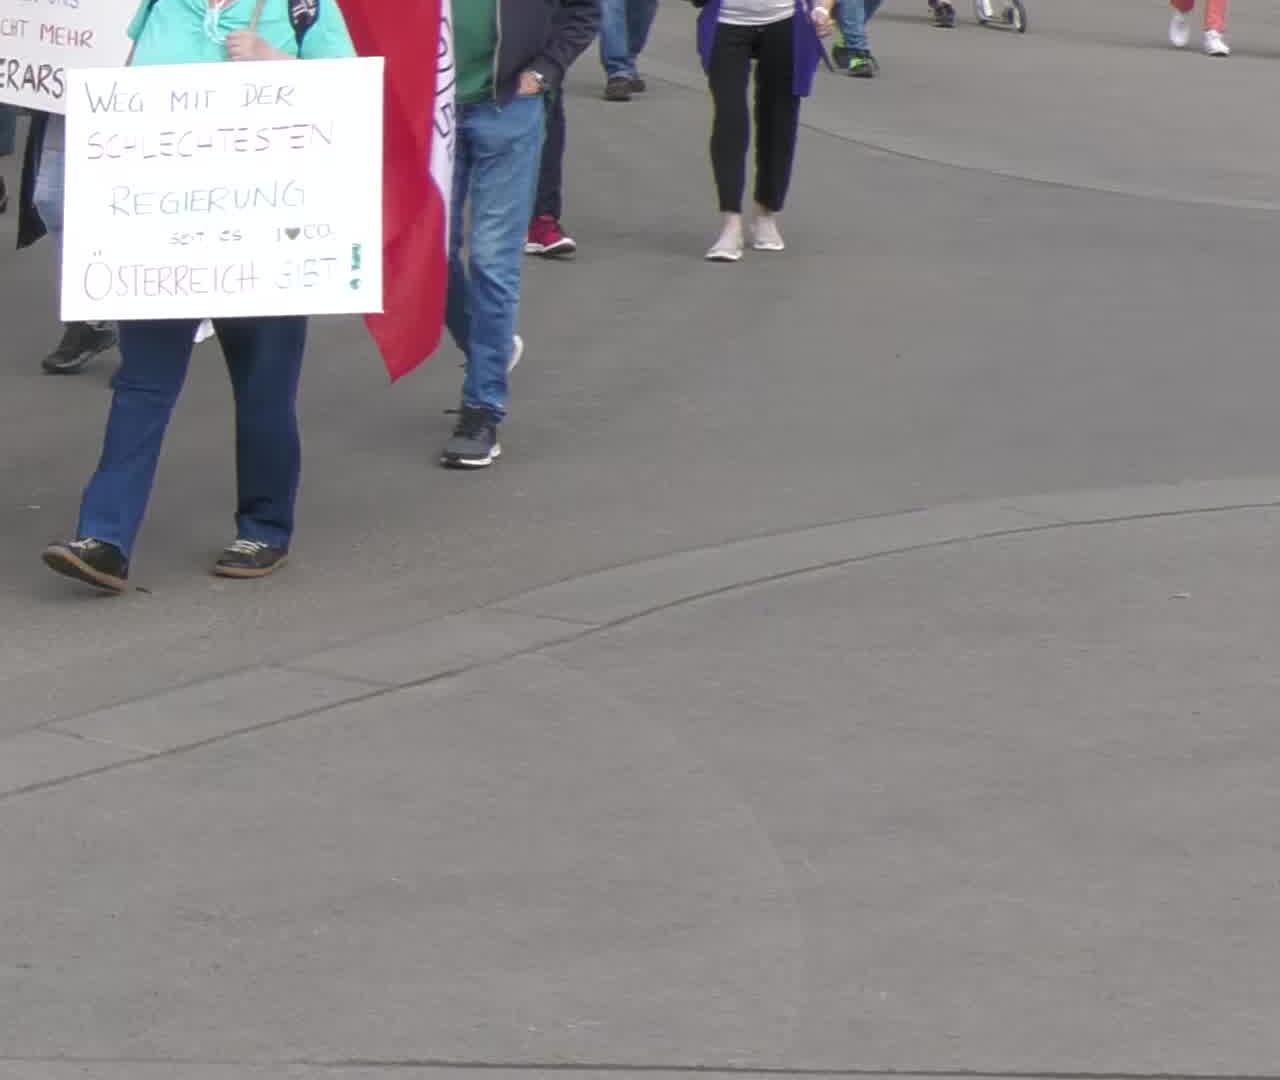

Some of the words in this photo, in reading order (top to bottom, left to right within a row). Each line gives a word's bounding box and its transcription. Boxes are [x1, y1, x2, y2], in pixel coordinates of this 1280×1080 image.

[39, 23, 94, 48] MEHR
[85, 80, 144, 113] WEG
[170, 89, 215, 113] MIT
[241, 84, 297, 108] DER
[87, 123, 333, 160] SCHLECHTESTEN
[108, 179, 305, 216] REGIERUNG
[84, 250, 260, 301] ÖSTERREICH
